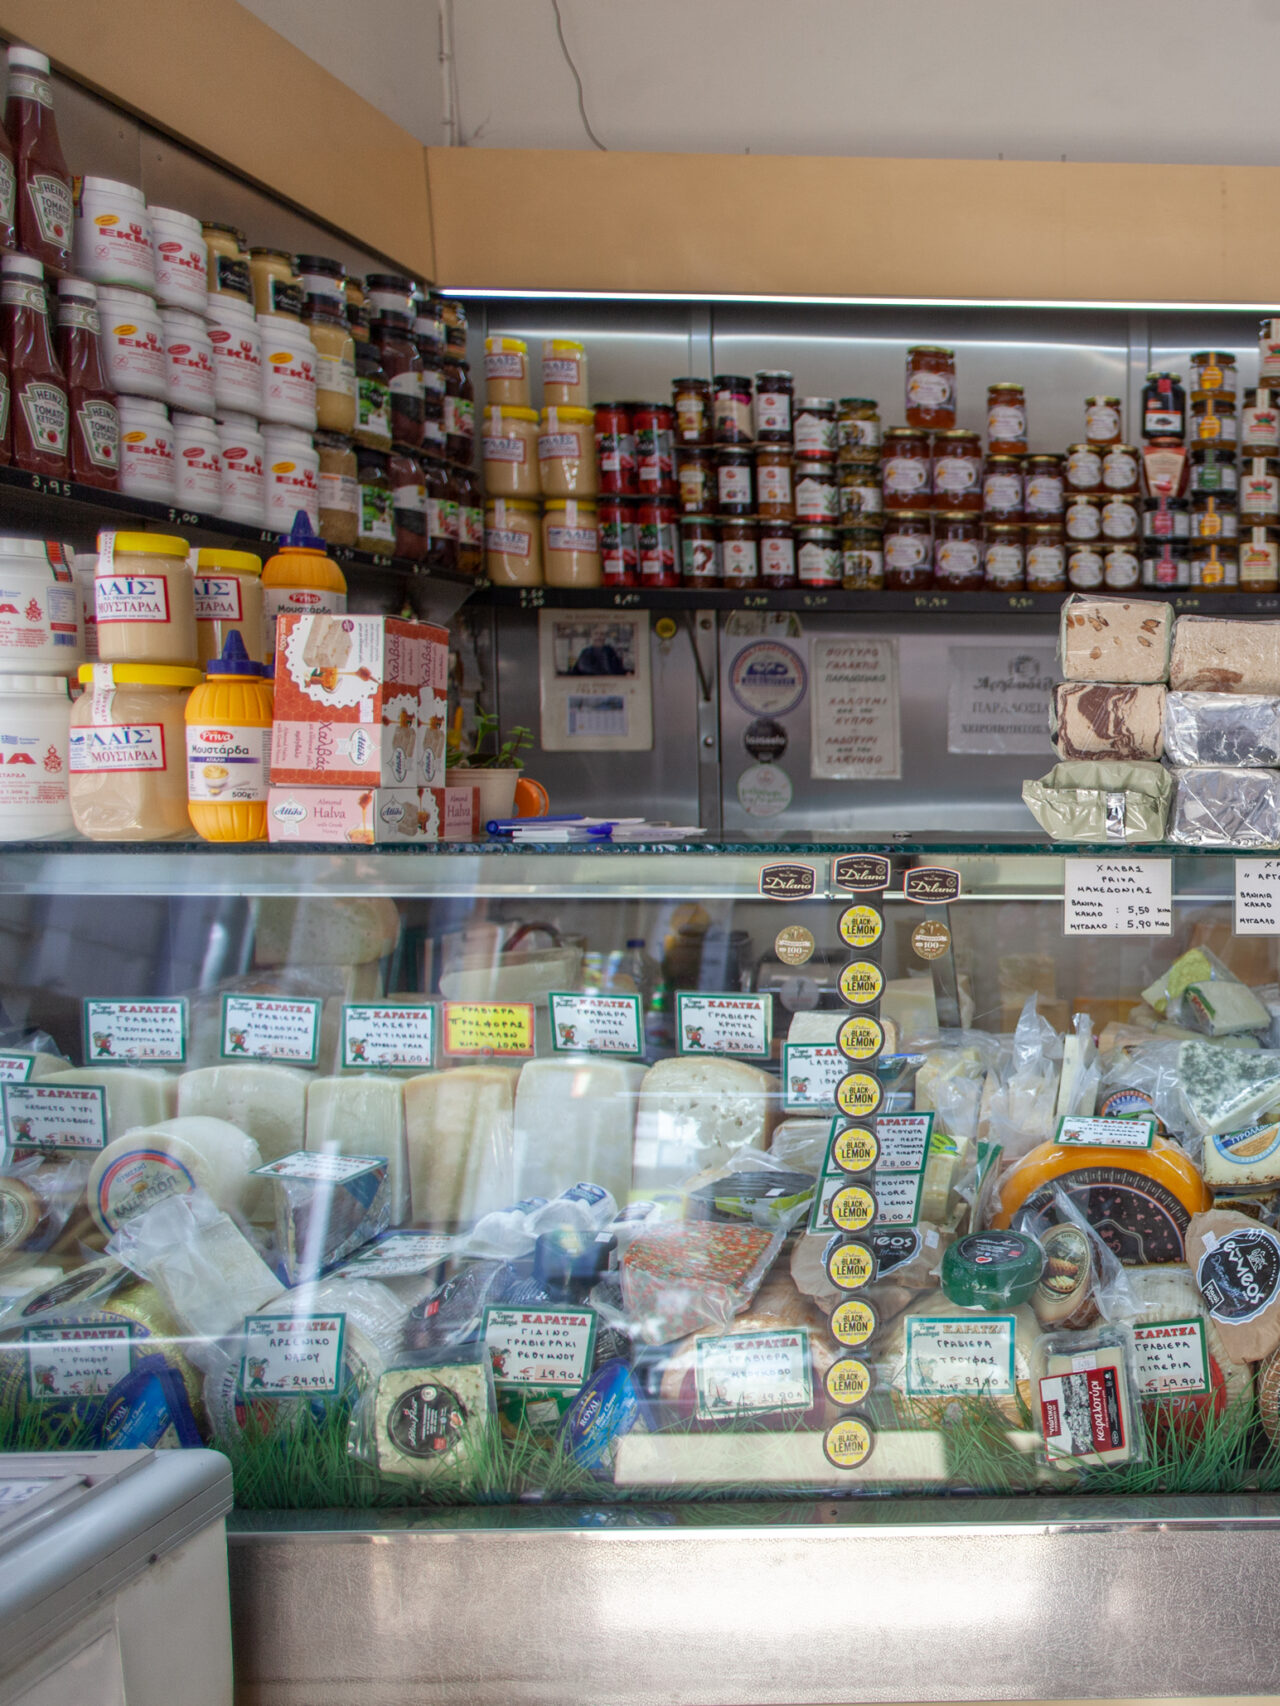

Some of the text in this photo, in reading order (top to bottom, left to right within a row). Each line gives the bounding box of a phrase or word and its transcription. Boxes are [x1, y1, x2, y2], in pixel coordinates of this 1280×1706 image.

[200, 730, 235, 743] Priva
[313, 806, 346, 819] Halva
[1096, 864, 1144, 873] ΧΑΛΒΑΣ
[837, 867, 886, 881] Dilano
[763, 877, 811, 890] Dilano
[907, 879, 957, 893] Dilano
[1077, 886, 1152, 894] ΜΑΚΕΔΟΝΙΑΣ
[846, 925, 875, 935] LEMON
[852, 975, 871, 983] BLACK
[847, 982, 876, 991] LEMON
[846, 1038, 875, 1048] LEMON
[844, 1094, 873, 1104] LEMON
[846, 1141, 866, 1149] BLACK
[842, 1149, 871, 1159] LEMON
[843, 1200, 863, 1208] BLACK
[838, 1208, 868, 1218] LEMON
[841, 1258, 861, 1266] BLACK
[837, 1266, 866, 1275] LEMON
[522, 1314, 588, 1327] ΚΑΡΑΤΖΑ
[843, 1315, 862, 1323] BLACK
[838, 1323, 868, 1332] LEMON
[1134, 1327, 1197, 1340] ΚΑΡΑΤΖΑ
[937, 1340, 992, 1348] ΓΡΑΒΙΕΡΑ
[1135, 1341, 1191, 1352] ΓΡΑΒΙΕΡΑ
[838, 1373, 858, 1381] BLACK
[833, 1381, 863, 1391] LEMON
[838, 1435, 858, 1443] BLACK
[833, 1443, 864, 1453] LEMON
